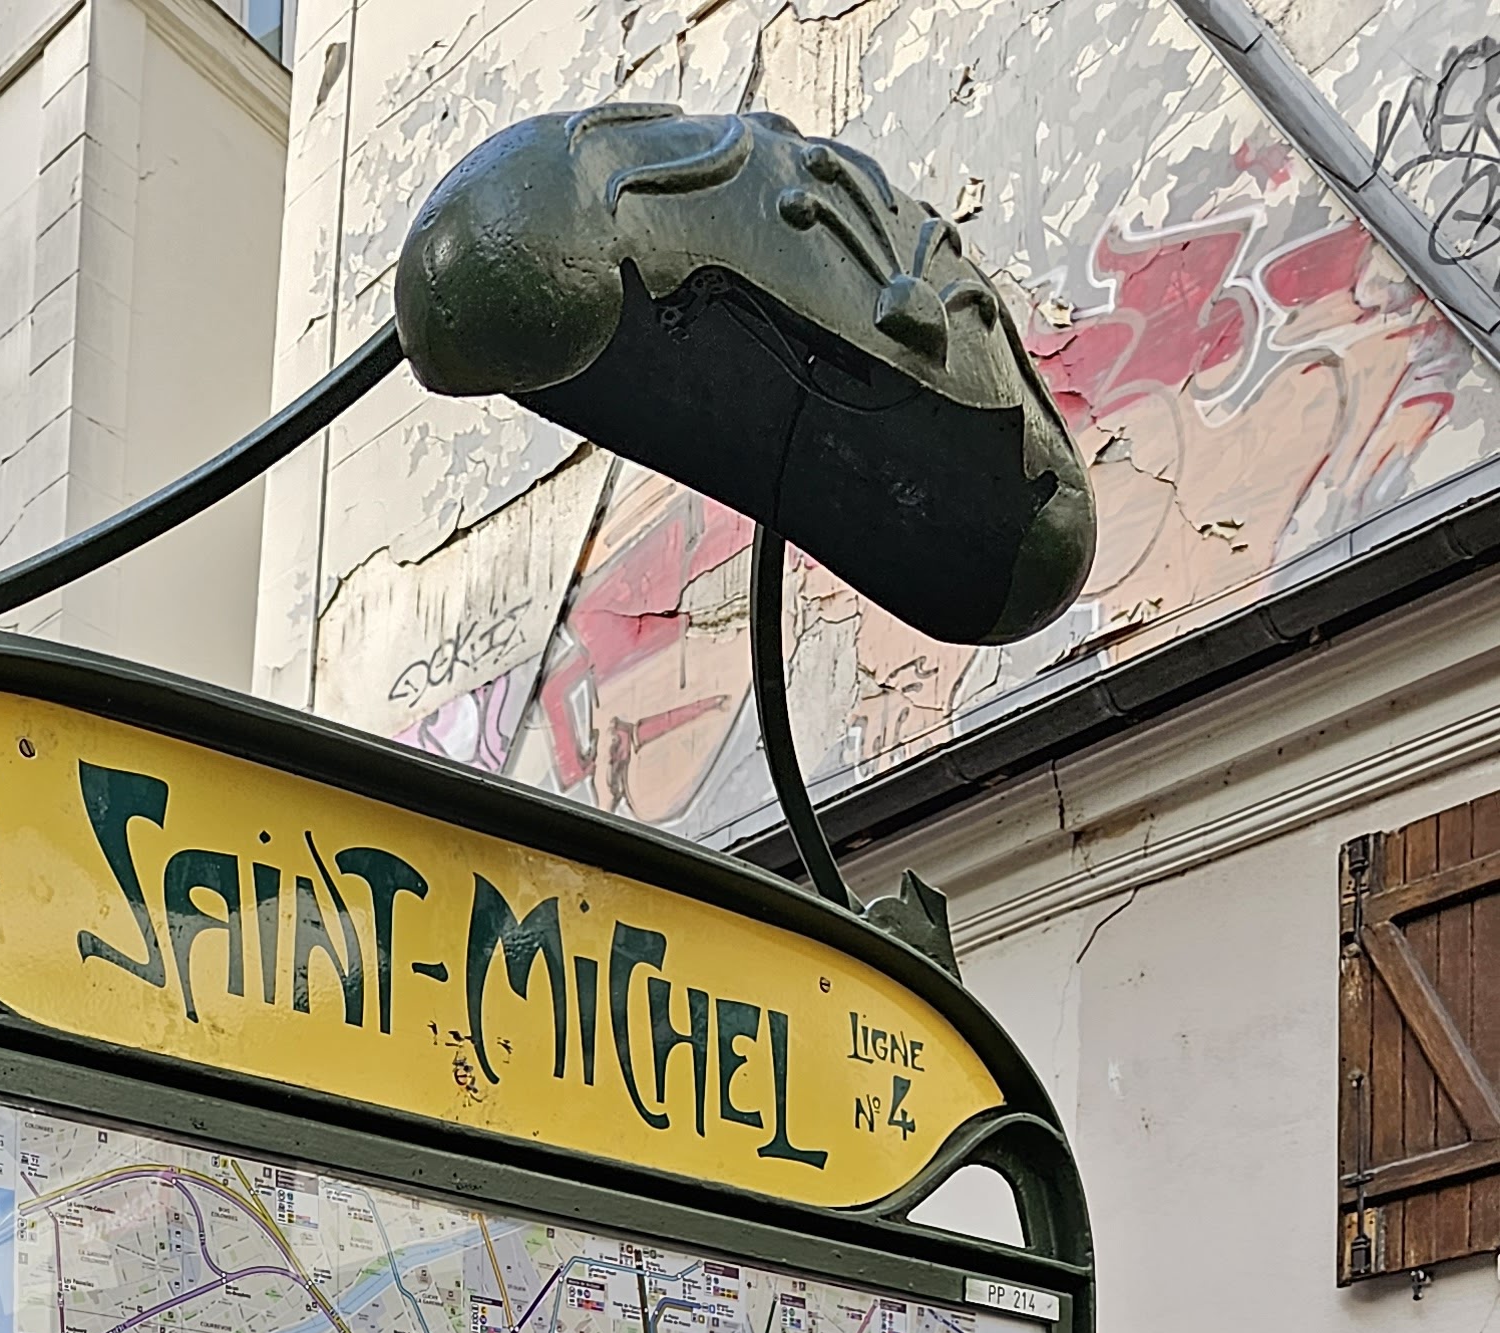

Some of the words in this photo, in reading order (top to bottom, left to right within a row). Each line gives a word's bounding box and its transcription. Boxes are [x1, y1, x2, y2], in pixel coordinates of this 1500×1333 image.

[888, 1075, 916, 1141] 4
[988, 1284, 1005, 1305] PP
[1013, 1290, 1036, 1312] 214
